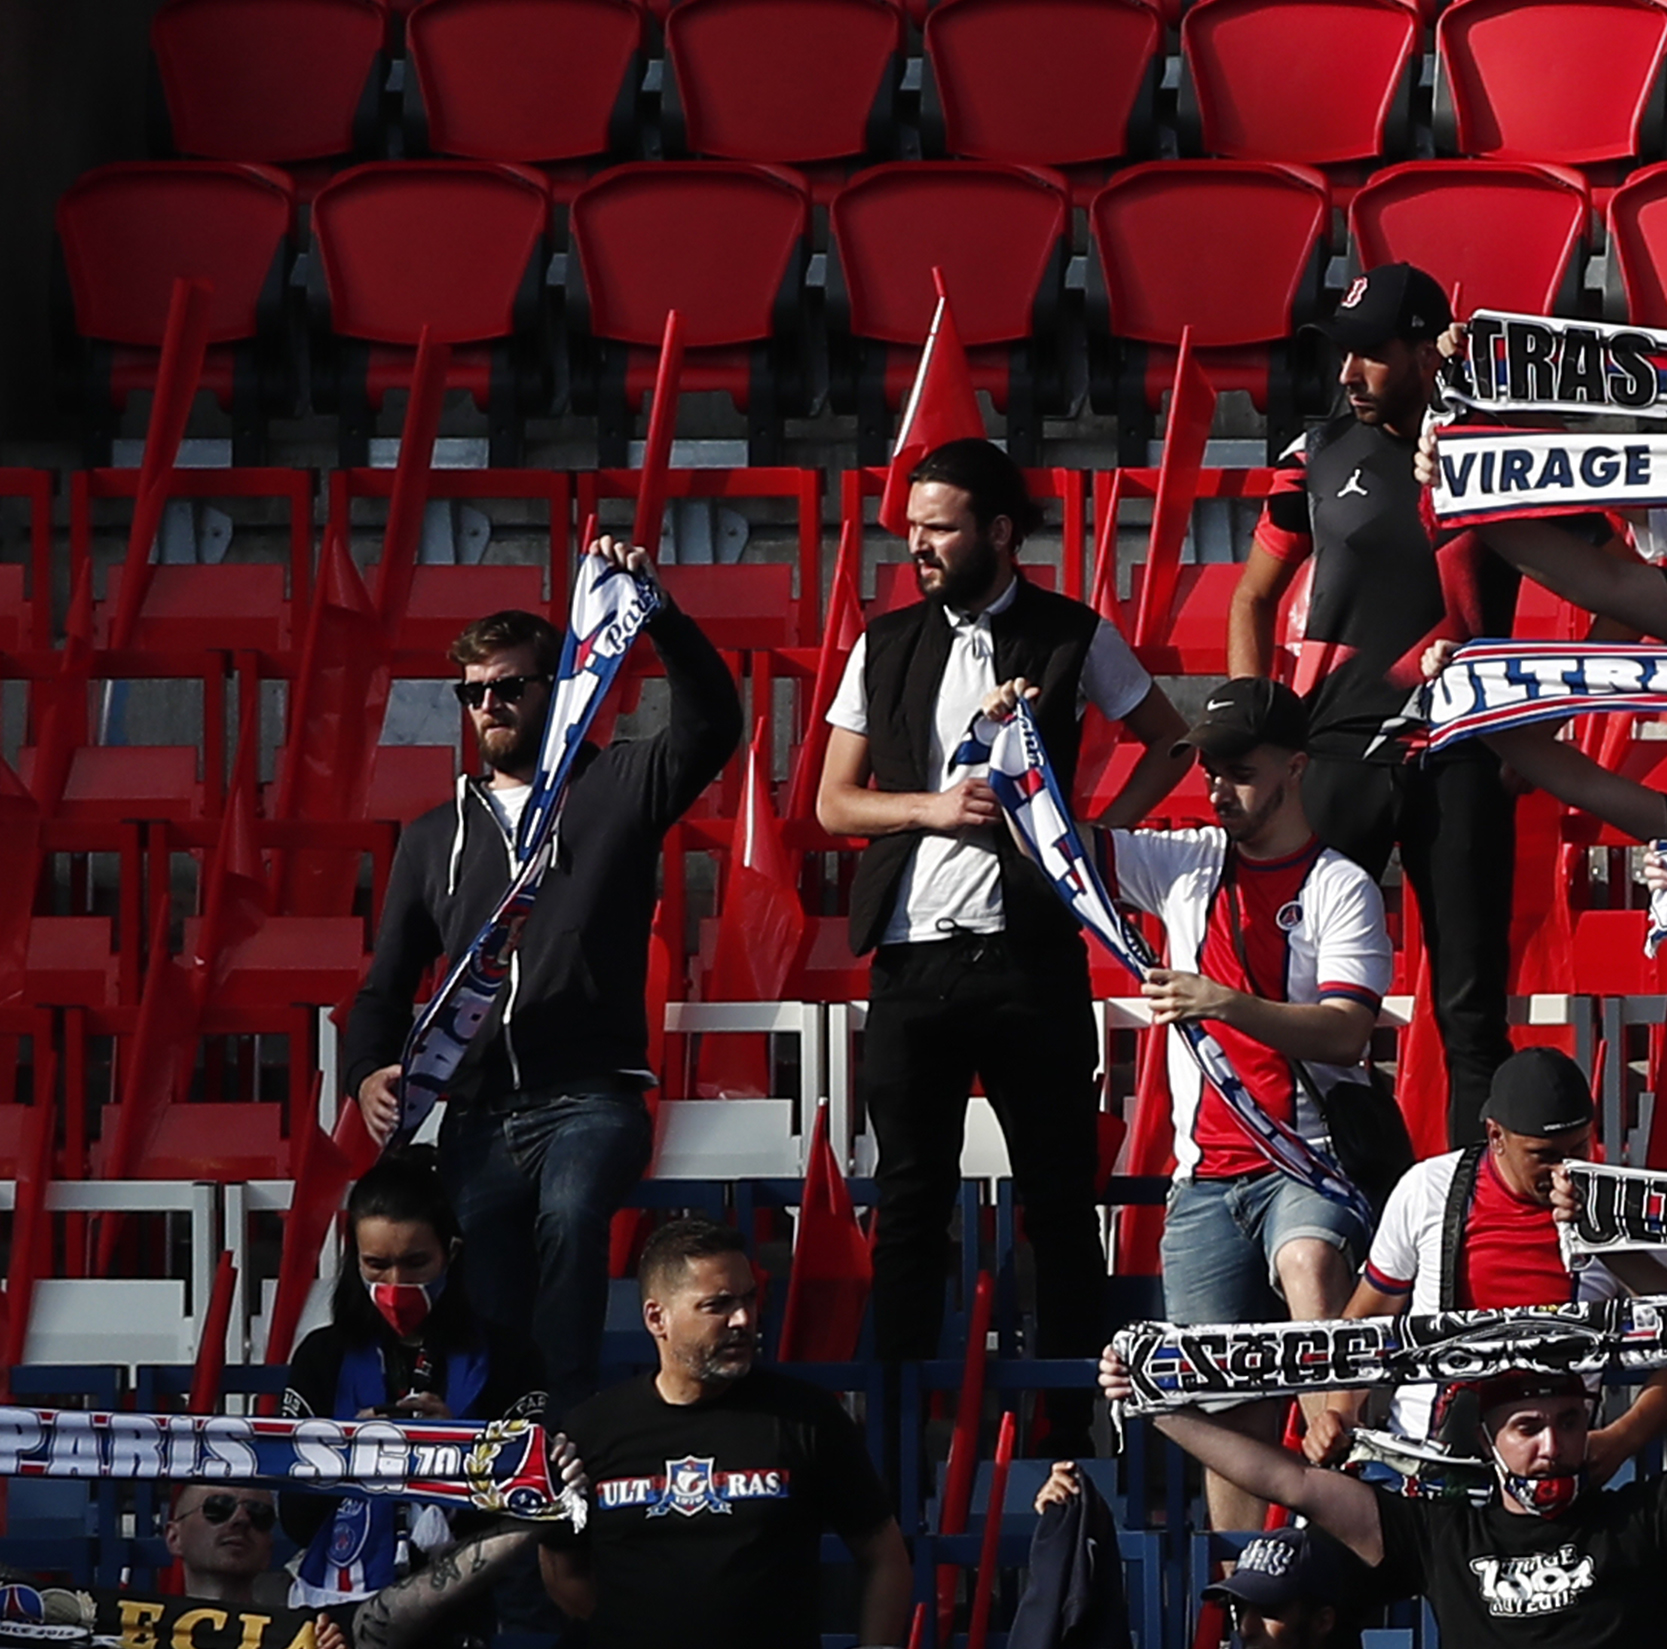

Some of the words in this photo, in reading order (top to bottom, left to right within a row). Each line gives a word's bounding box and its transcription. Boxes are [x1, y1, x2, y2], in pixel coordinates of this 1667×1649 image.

[1468, 317, 1658, 408] TRAS
[1440, 444, 1651, 499] VIRAGE
[602, 1480, 651, 1503] ULT
[727, 1479, 781, 1497] RAS
